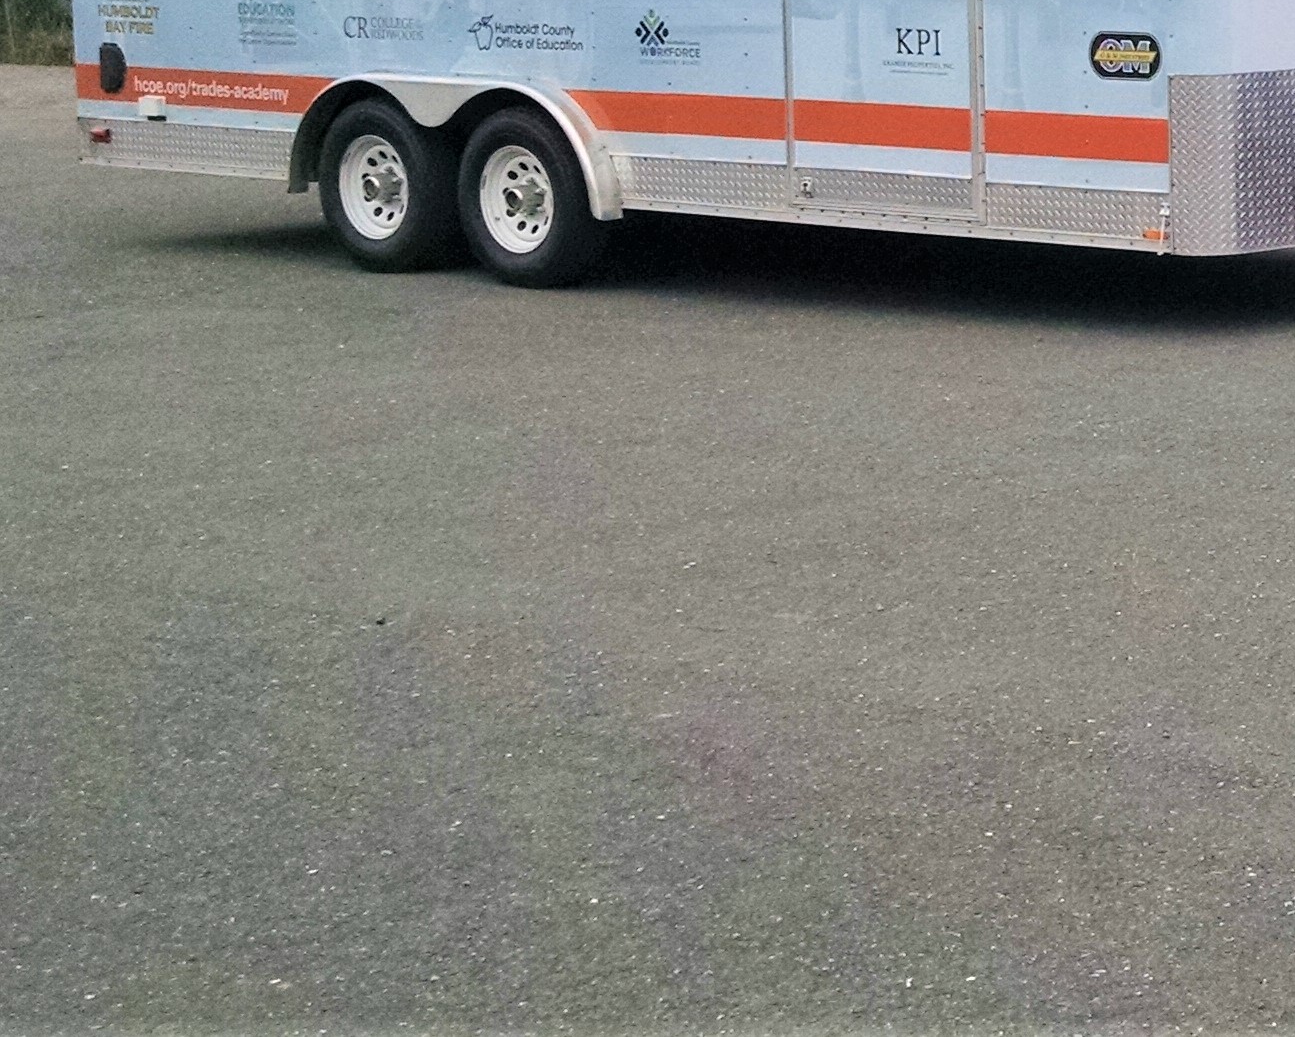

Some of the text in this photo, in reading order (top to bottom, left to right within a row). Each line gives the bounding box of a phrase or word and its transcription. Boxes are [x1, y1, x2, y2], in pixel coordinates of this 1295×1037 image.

[98, 5, 159, 19] HUMBOLDT
[105, 20, 154, 35] BAY FIRE
[343, 16, 370, 39] CR
[495, 22, 576, 38] Humboldt County
[495, 36, 584, 51] Office of Education
[895, 27, 941, 56] KPI
[640, 48, 700, 58] WORKFORCE
[134, 76, 289, 104] hcoe.org/trades-academy
